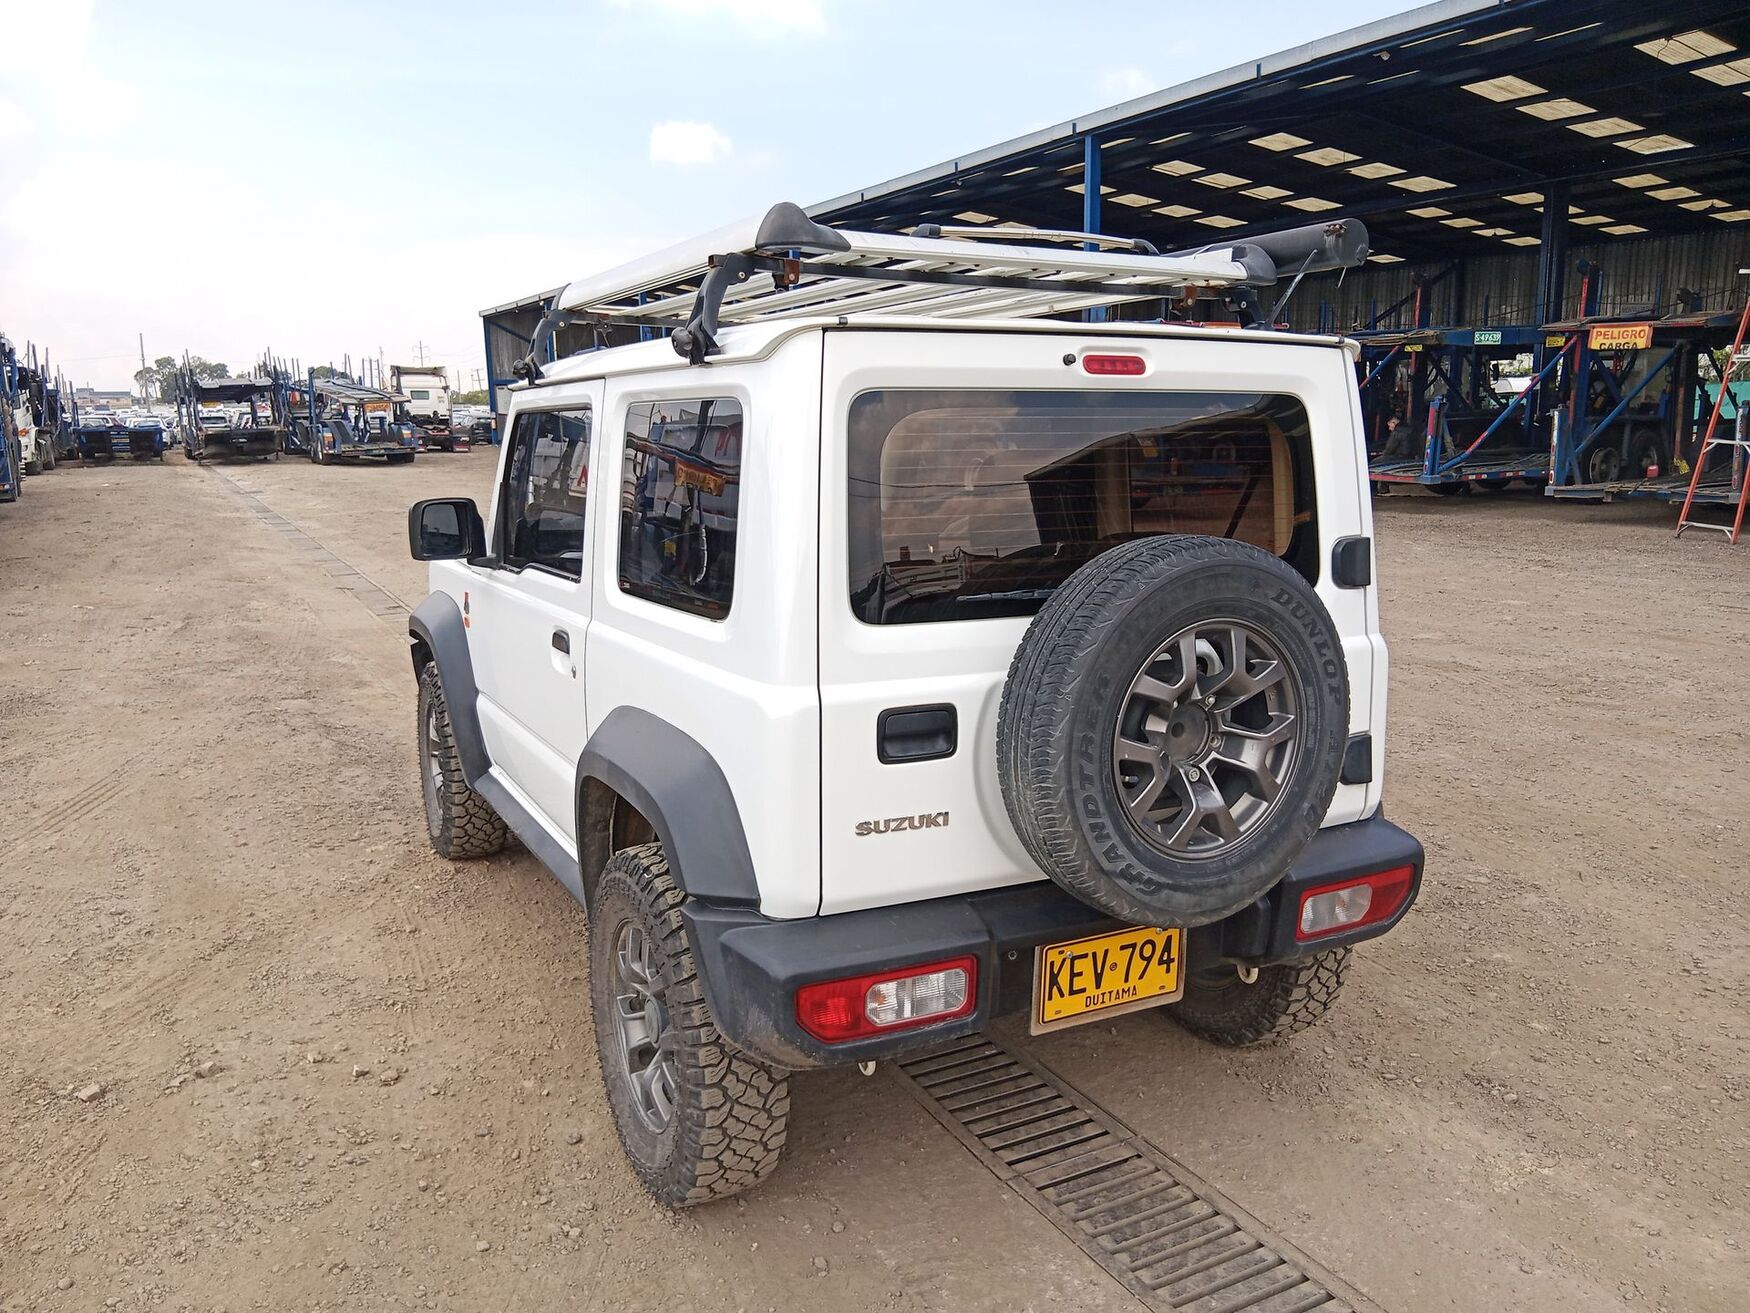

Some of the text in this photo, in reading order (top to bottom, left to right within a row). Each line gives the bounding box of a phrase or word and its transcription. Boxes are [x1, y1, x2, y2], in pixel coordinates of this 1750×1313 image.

[1595, 329, 1646, 340] PELIGRO
[1599, 342, 1638, 350] CARGA
[1271, 587, 1341, 705] DUNLOP
[855, 811, 949, 836] SUZUKI
[1085, 985, 1137, 1008] DUITAMA
